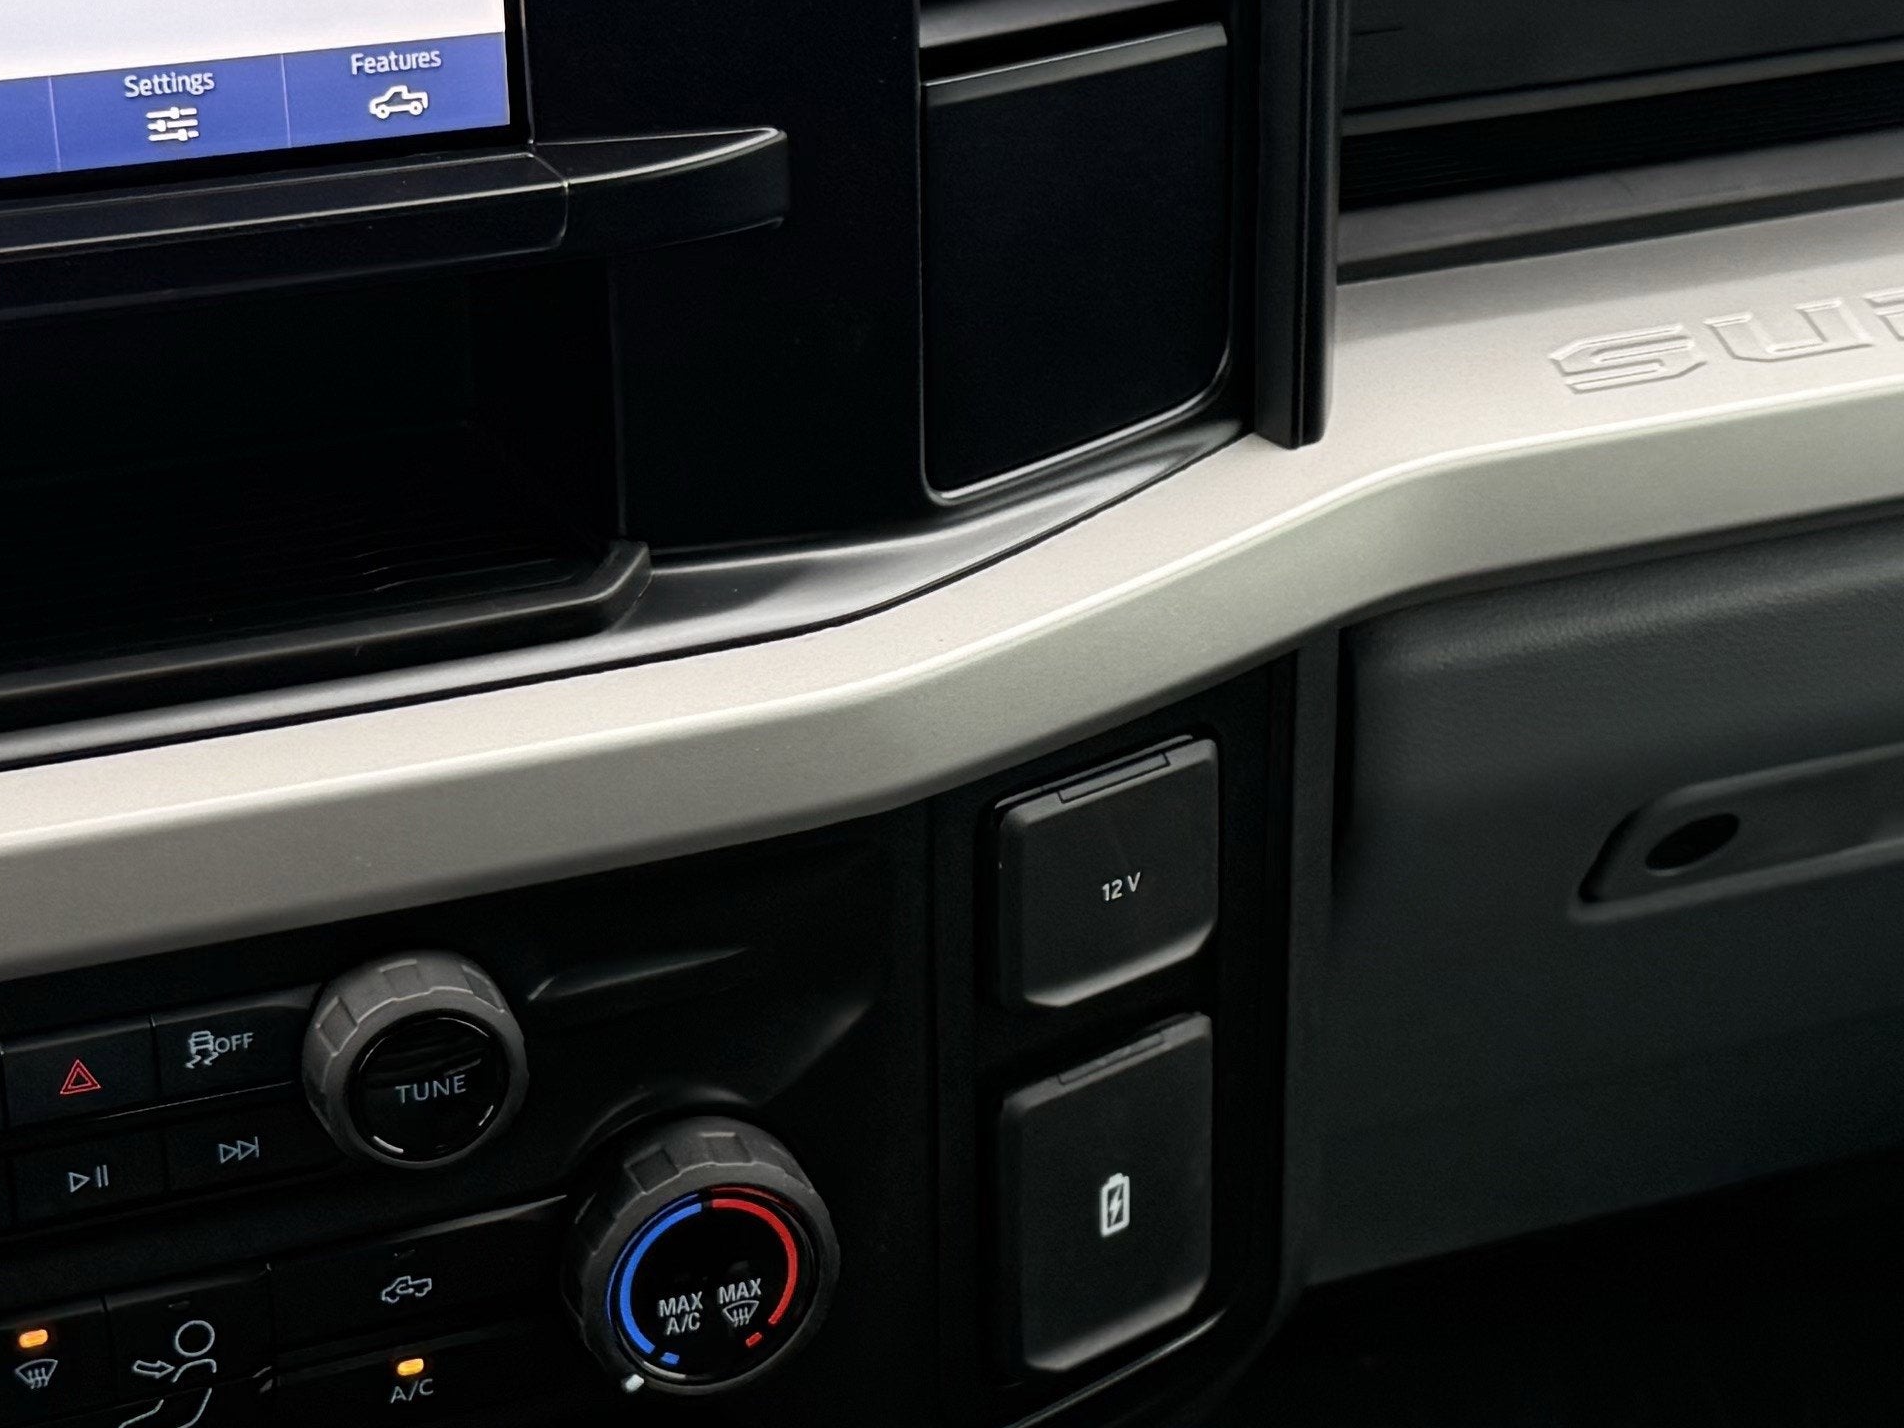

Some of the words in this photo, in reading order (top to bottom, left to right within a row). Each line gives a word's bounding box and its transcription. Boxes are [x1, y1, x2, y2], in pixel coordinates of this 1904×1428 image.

[350, 48, 442, 75] Features
[123, 72, 215, 99] Settings
[1101, 877, 1124, 903] 12
[1127, 871, 1142, 894] V
[215, 1031, 255, 1054] OFF
[394, 1071, 468, 1105] TUNE
[658, 1290, 704, 1319] MAX
[717, 1276, 763, 1306] MAX
[665, 1312, 701, 1336] A/C
[389, 1377, 435, 1404] A/C
